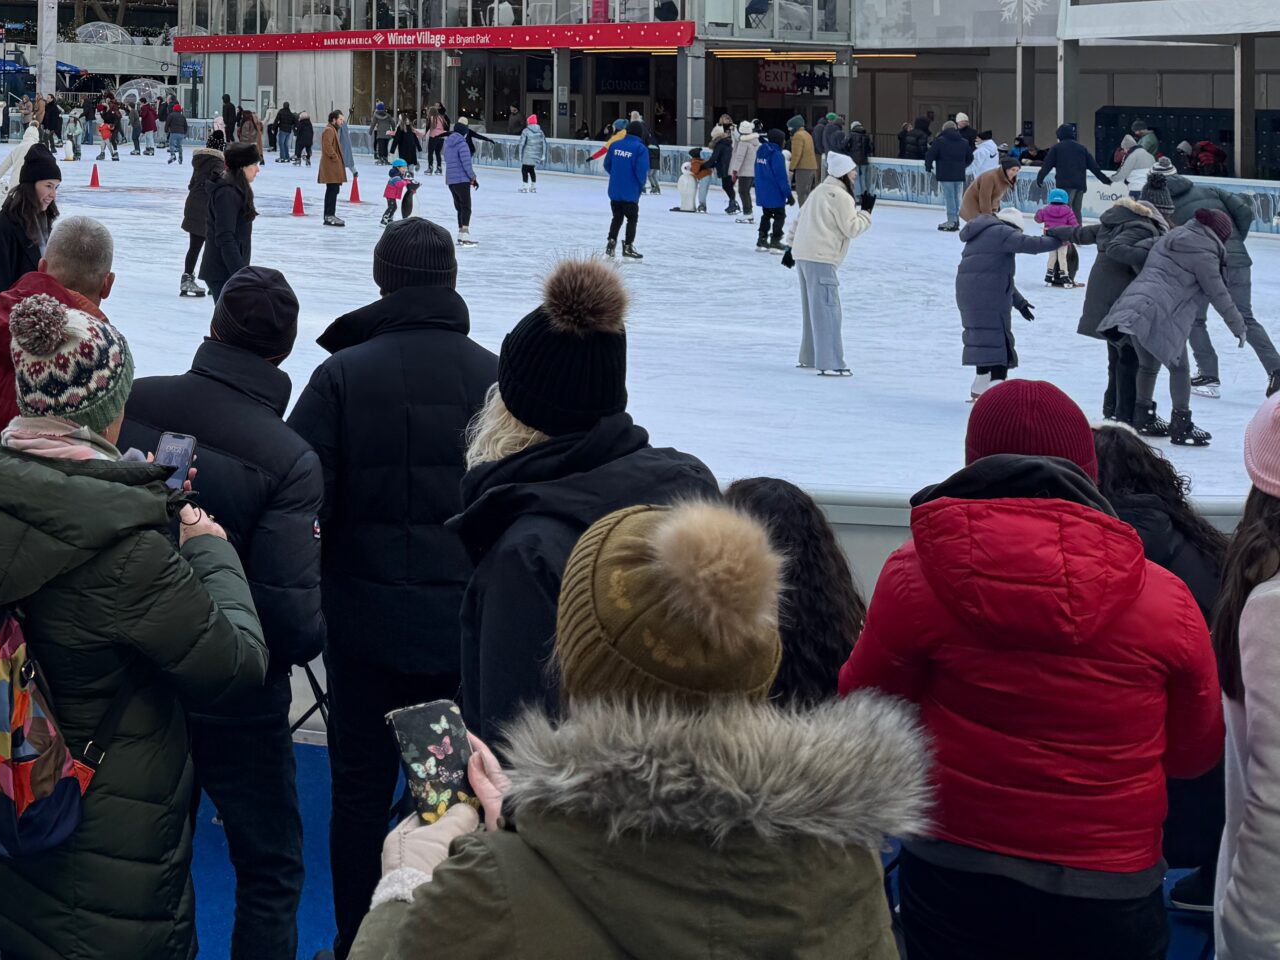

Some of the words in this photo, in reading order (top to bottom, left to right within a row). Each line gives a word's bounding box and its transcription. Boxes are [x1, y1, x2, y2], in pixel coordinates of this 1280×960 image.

[323, 38, 339, 46] BANK
[346, 37, 372, 45] AMERICA
[387, 32, 415, 45] Winter
[416, 31, 446, 48] Village
[448, 35, 455, 44] at
[455, 34, 476, 46] Bryant
[476, 33, 490, 44] Park
[764, 70, 790, 82] EXIT
[601, 80, 646, 91] LOUNGE
[613, 148, 633, 159] STAFF
